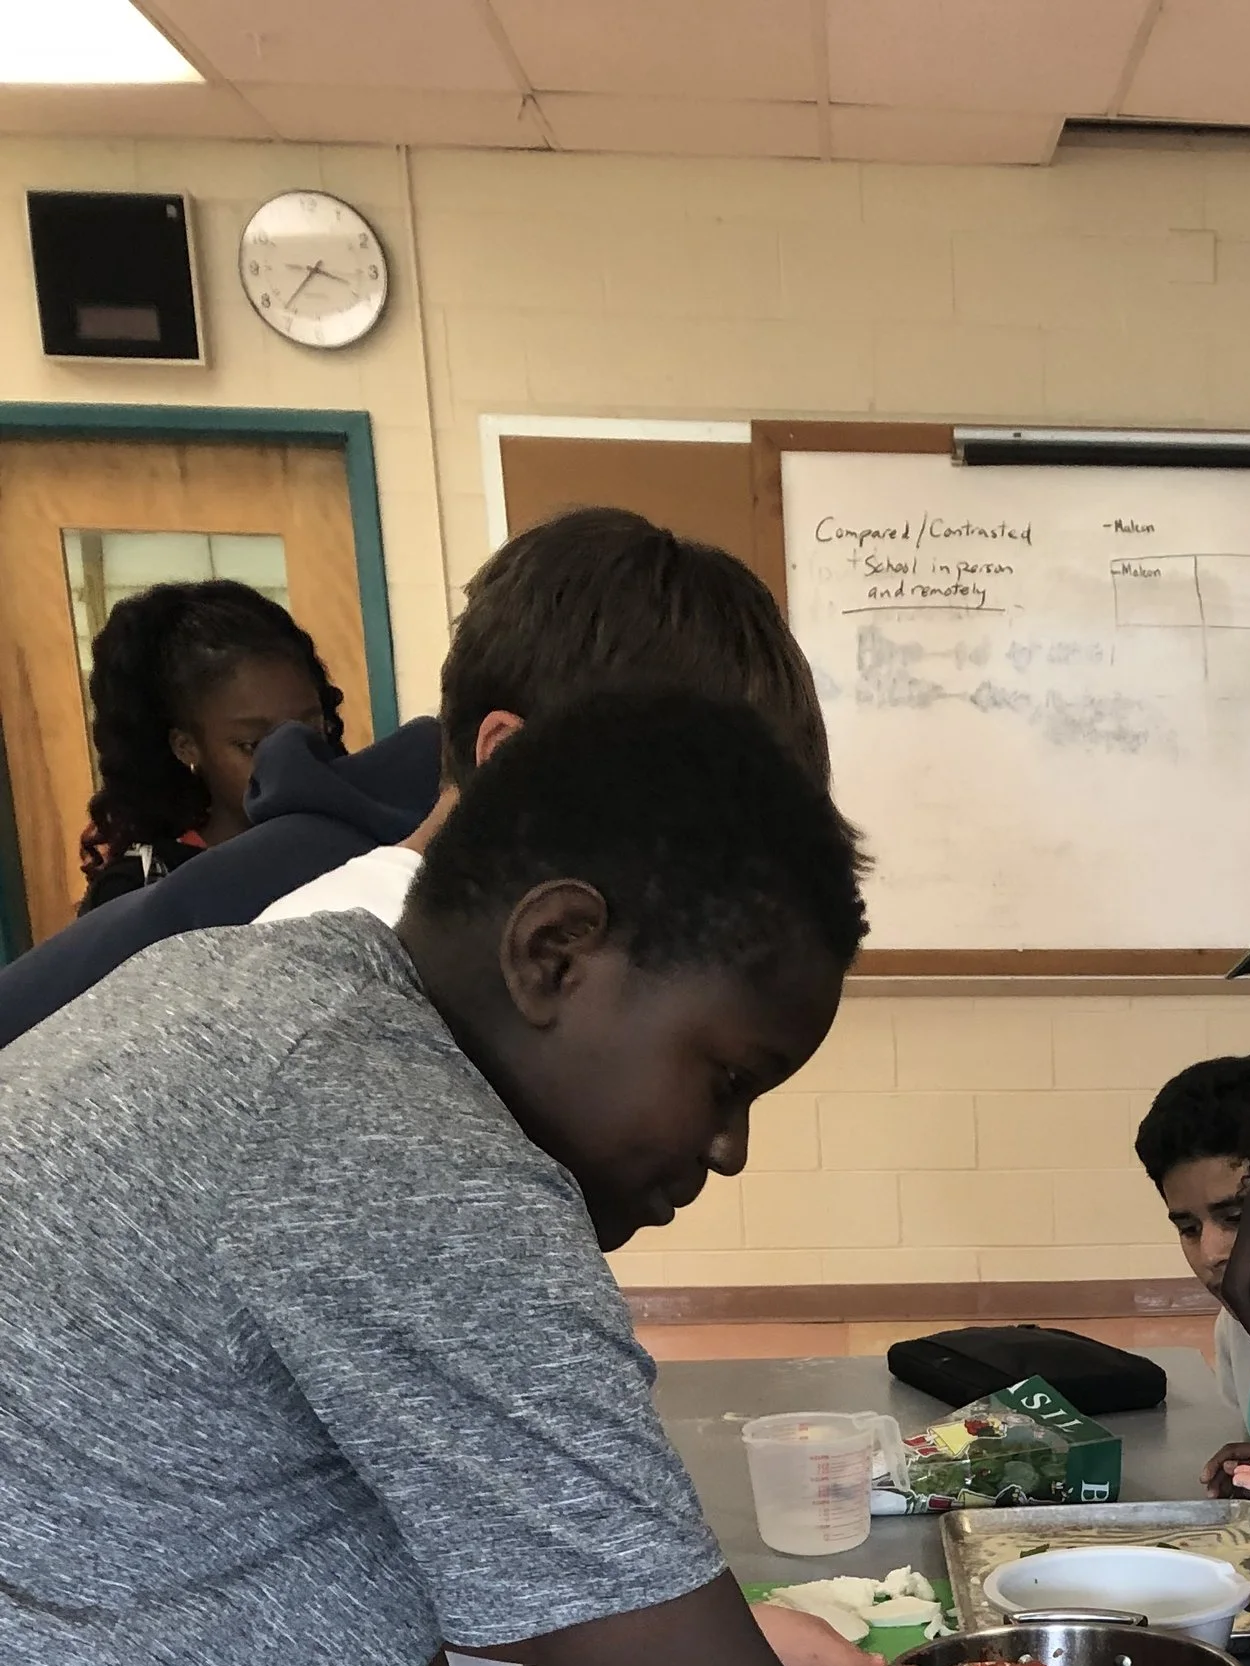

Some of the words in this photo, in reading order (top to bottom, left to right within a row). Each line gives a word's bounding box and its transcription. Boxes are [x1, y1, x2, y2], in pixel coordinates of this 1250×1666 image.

[359, 232, 369, 249] 2
[249, 260, 260, 276] 9
[367, 264, 379, 280] 3
[260, 292, 271, 309] 8
[864, 554, 918, 577] School
[955, 561, 1014, 581] person
[867, 580, 905, 599] and
[911, 581, 987, 609] remotely
